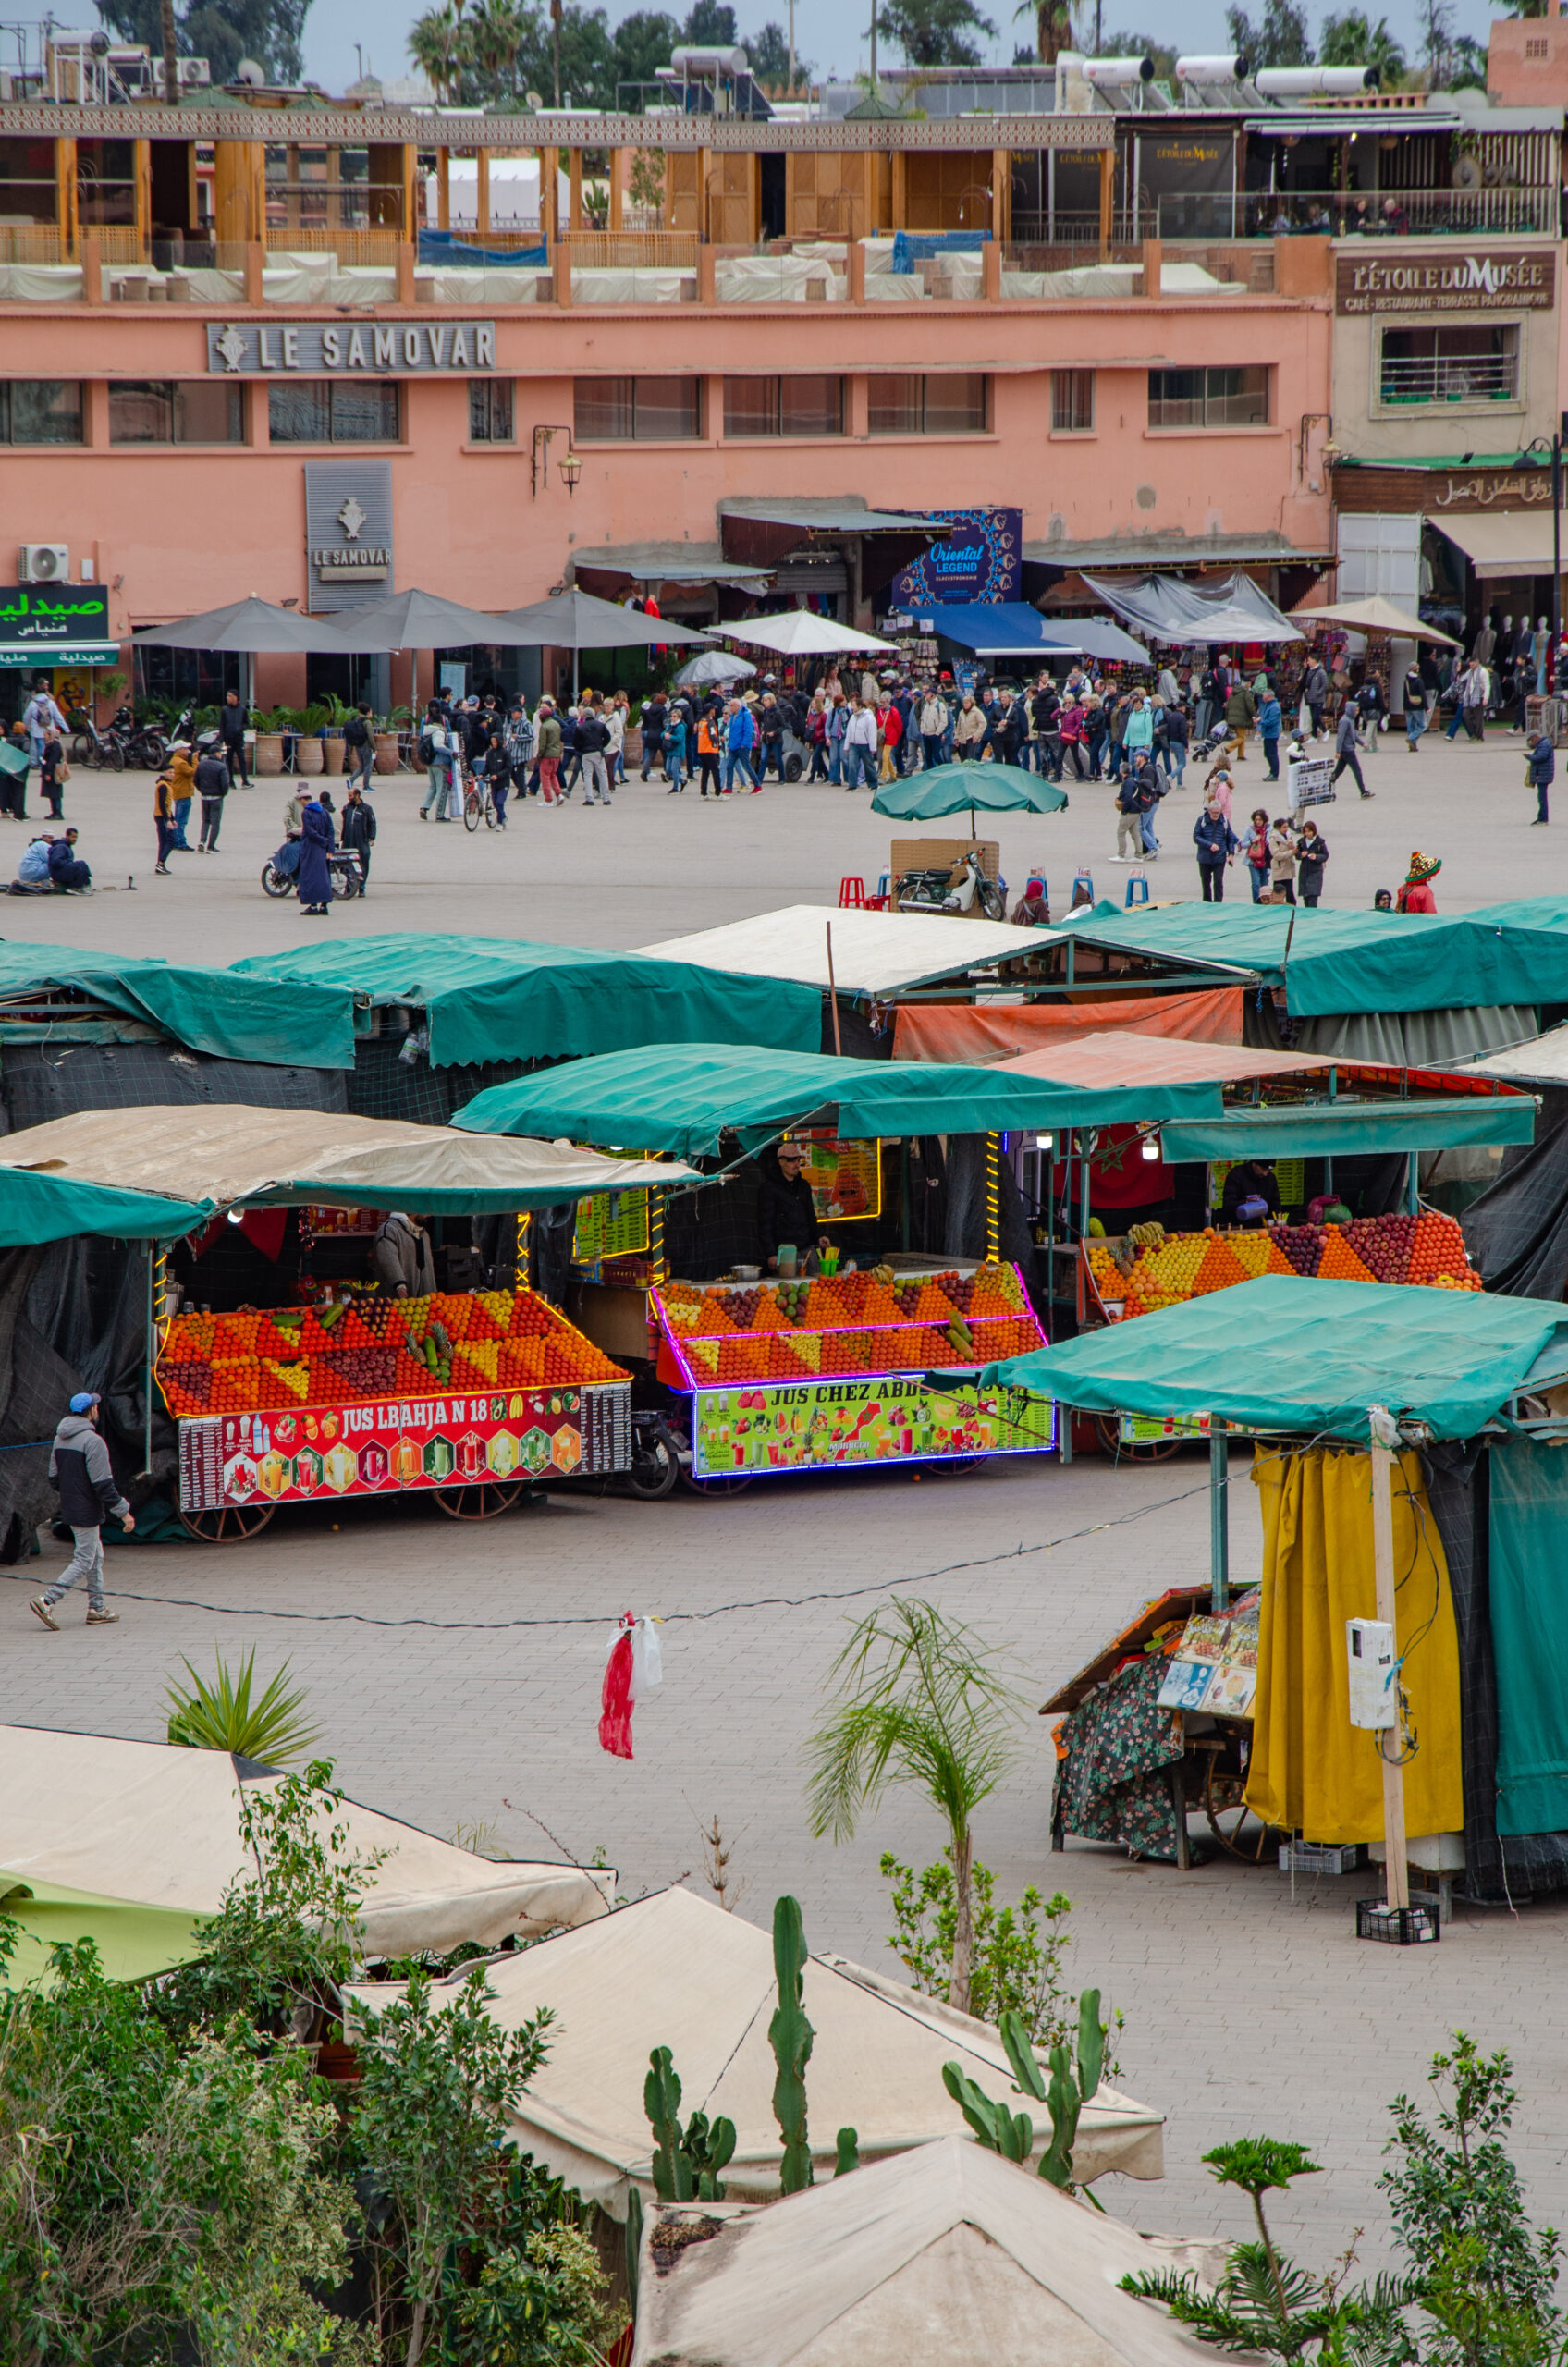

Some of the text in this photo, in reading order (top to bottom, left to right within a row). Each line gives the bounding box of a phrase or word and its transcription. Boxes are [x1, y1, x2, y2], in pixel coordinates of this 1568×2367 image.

[1464, 256, 1543, 294] MUSÉE
[258, 327, 494, 368] LE SAMOVAR
[314, 548, 392, 565] LE SAMOVAR
[929, 541, 985, 563] Oriental
[936, 562, 978, 573] LEGEND
[0, 593, 104, 622] صيدلي
[771, 1387, 809, 1405] JUS
[815, 1383, 870, 1403] CHEZ
[342, 1398, 487, 1439] JUS LBAHJA N 18
